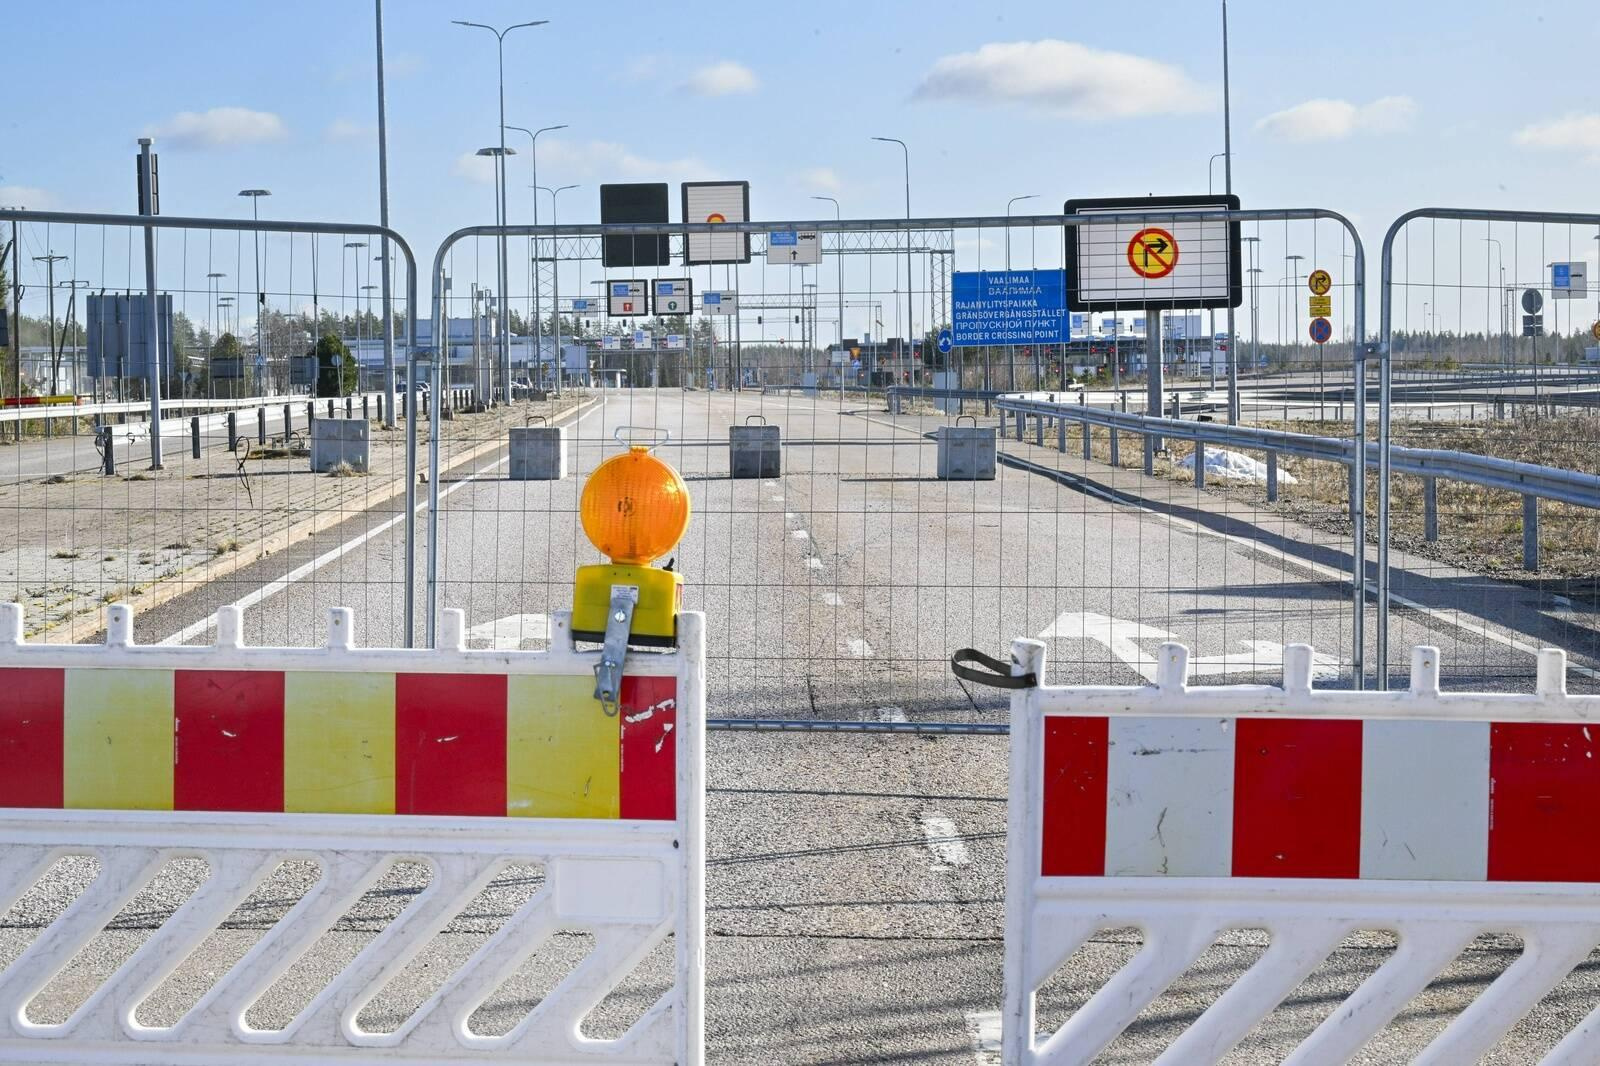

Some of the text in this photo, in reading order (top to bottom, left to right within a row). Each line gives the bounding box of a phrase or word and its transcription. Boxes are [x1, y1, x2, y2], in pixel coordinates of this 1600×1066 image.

[988, 276, 1030, 285] VAALIMAA
[955, 300, 1038, 310] RAJANYLITYSPAIKKA
[956, 309, 1066, 320] GRÄNSÖVERGÅNGSSTÄLLET
[956, 319, 1057, 330] ПРОПУСКНОЙ ПУНКТ
[956, 330, 1059, 341] BORDER CROSSING POINT
